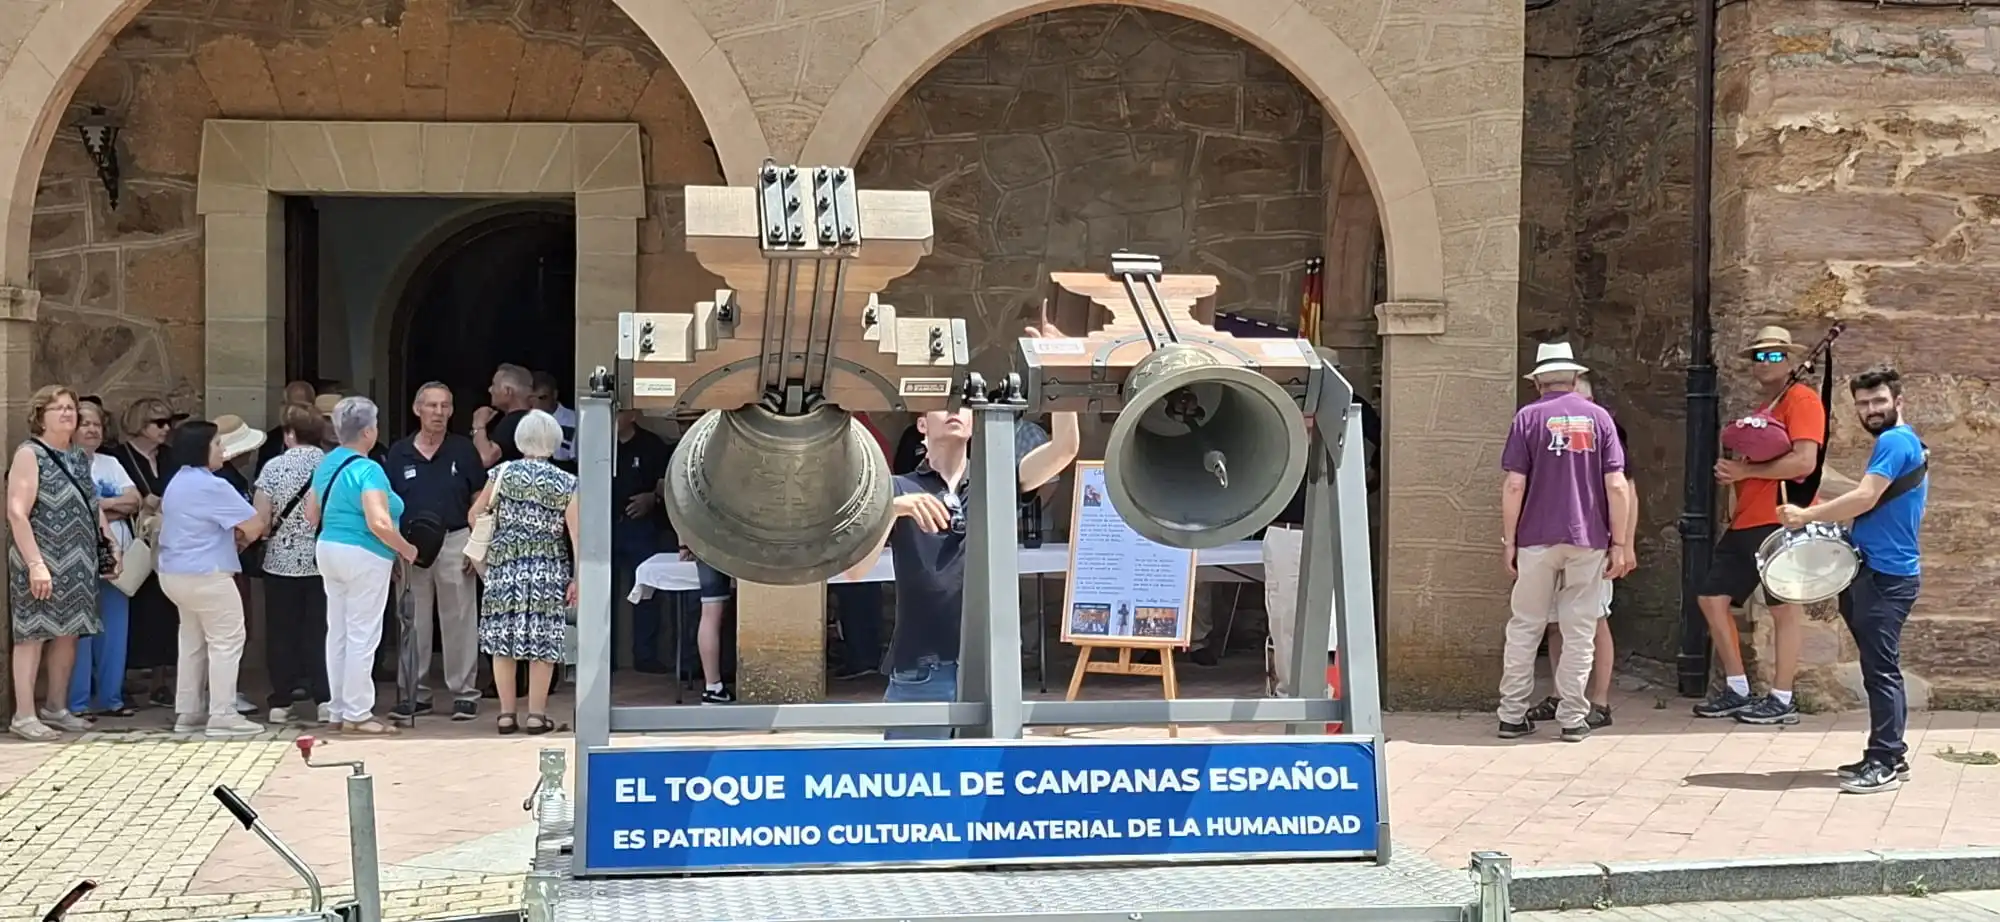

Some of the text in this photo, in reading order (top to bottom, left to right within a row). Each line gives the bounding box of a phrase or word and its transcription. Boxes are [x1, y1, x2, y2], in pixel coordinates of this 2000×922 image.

[616, 761, 1358, 805] EL TOQUE MANUAL DE CAMPANAS ESPAÑOL
[614, 815, 1360, 849] ES PATRIMONIO CULTURAL INMATERIAL DE LA HUMANIDAD
